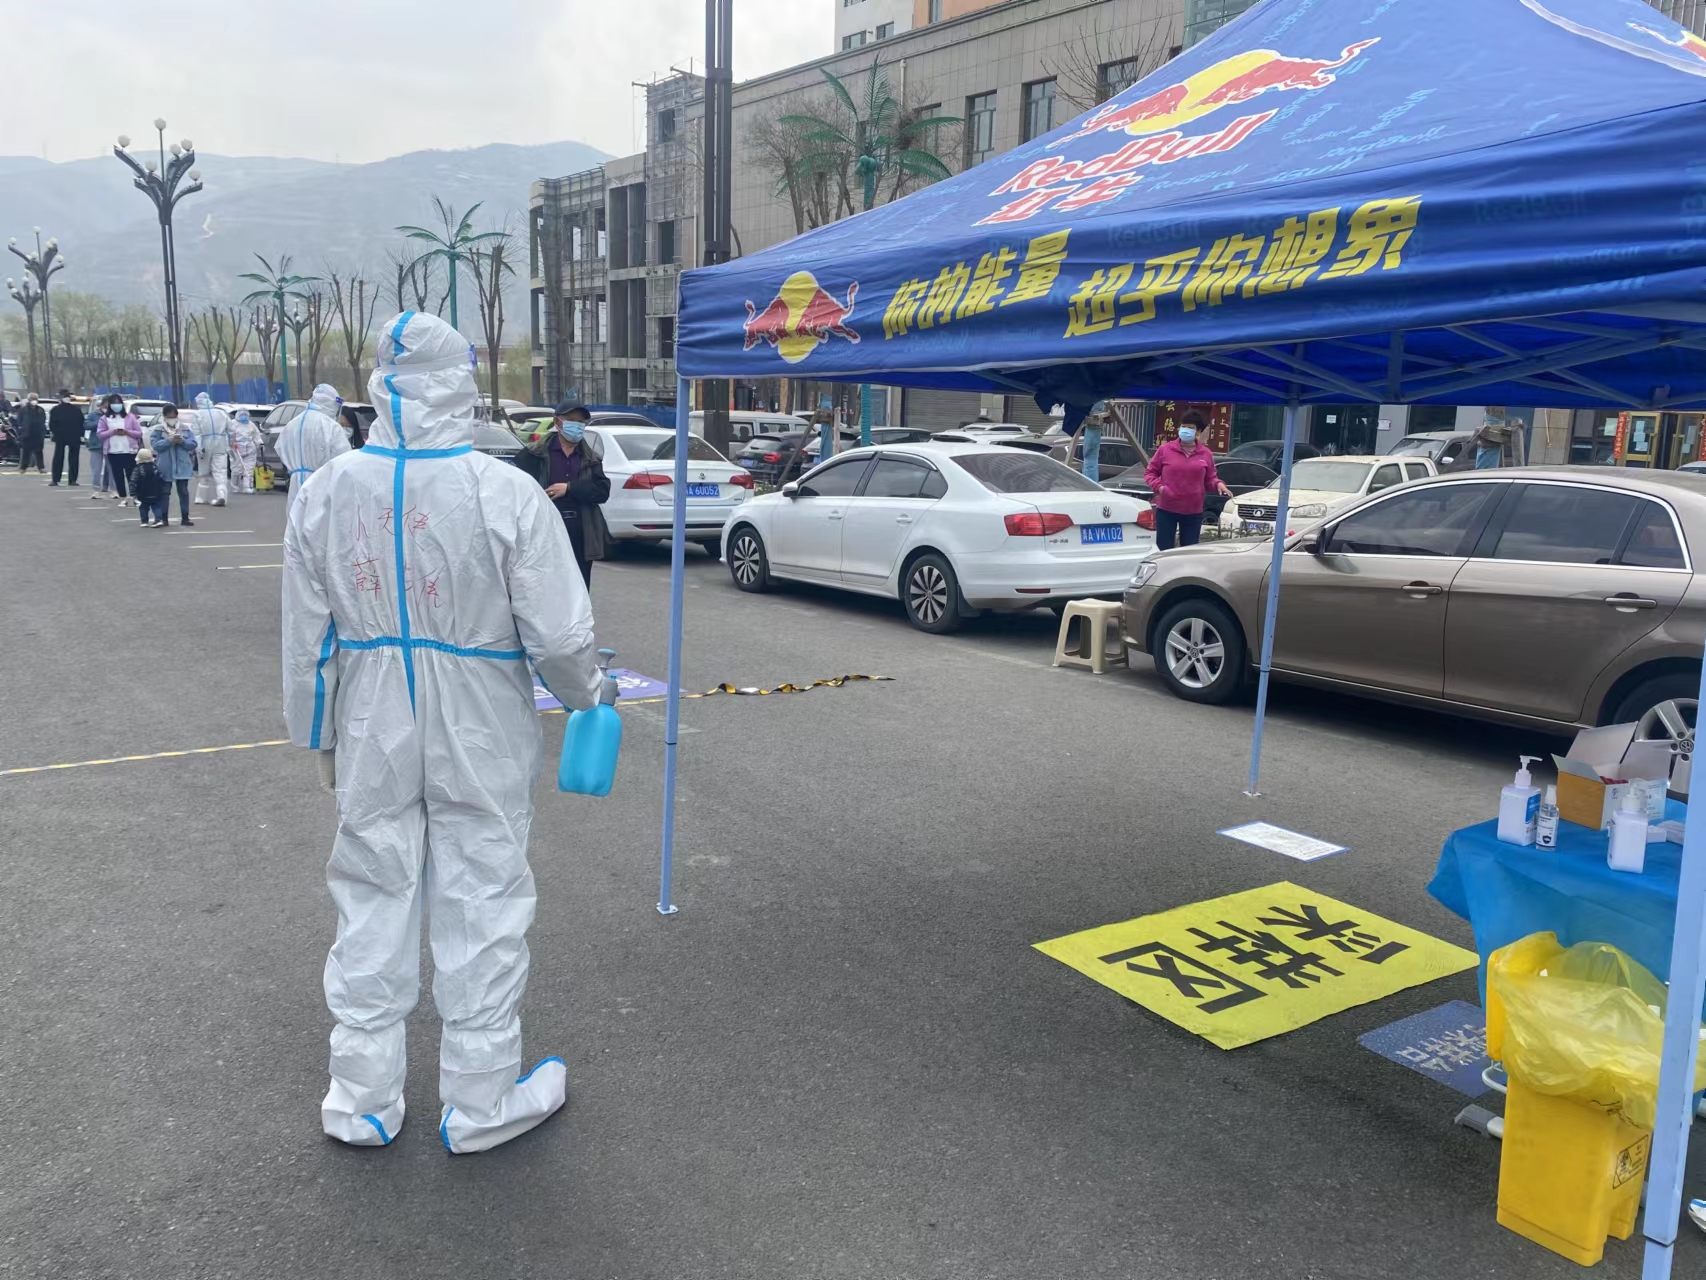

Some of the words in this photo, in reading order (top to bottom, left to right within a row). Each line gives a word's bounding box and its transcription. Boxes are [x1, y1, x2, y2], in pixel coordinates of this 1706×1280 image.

[971, 172, 1145, 227] 红牛
[882, 228, 1072, 340] 你的能量
[1062, 194, 1422, 338] 超乎你想象
[1097, 904, 1411, 1014] 采样区
